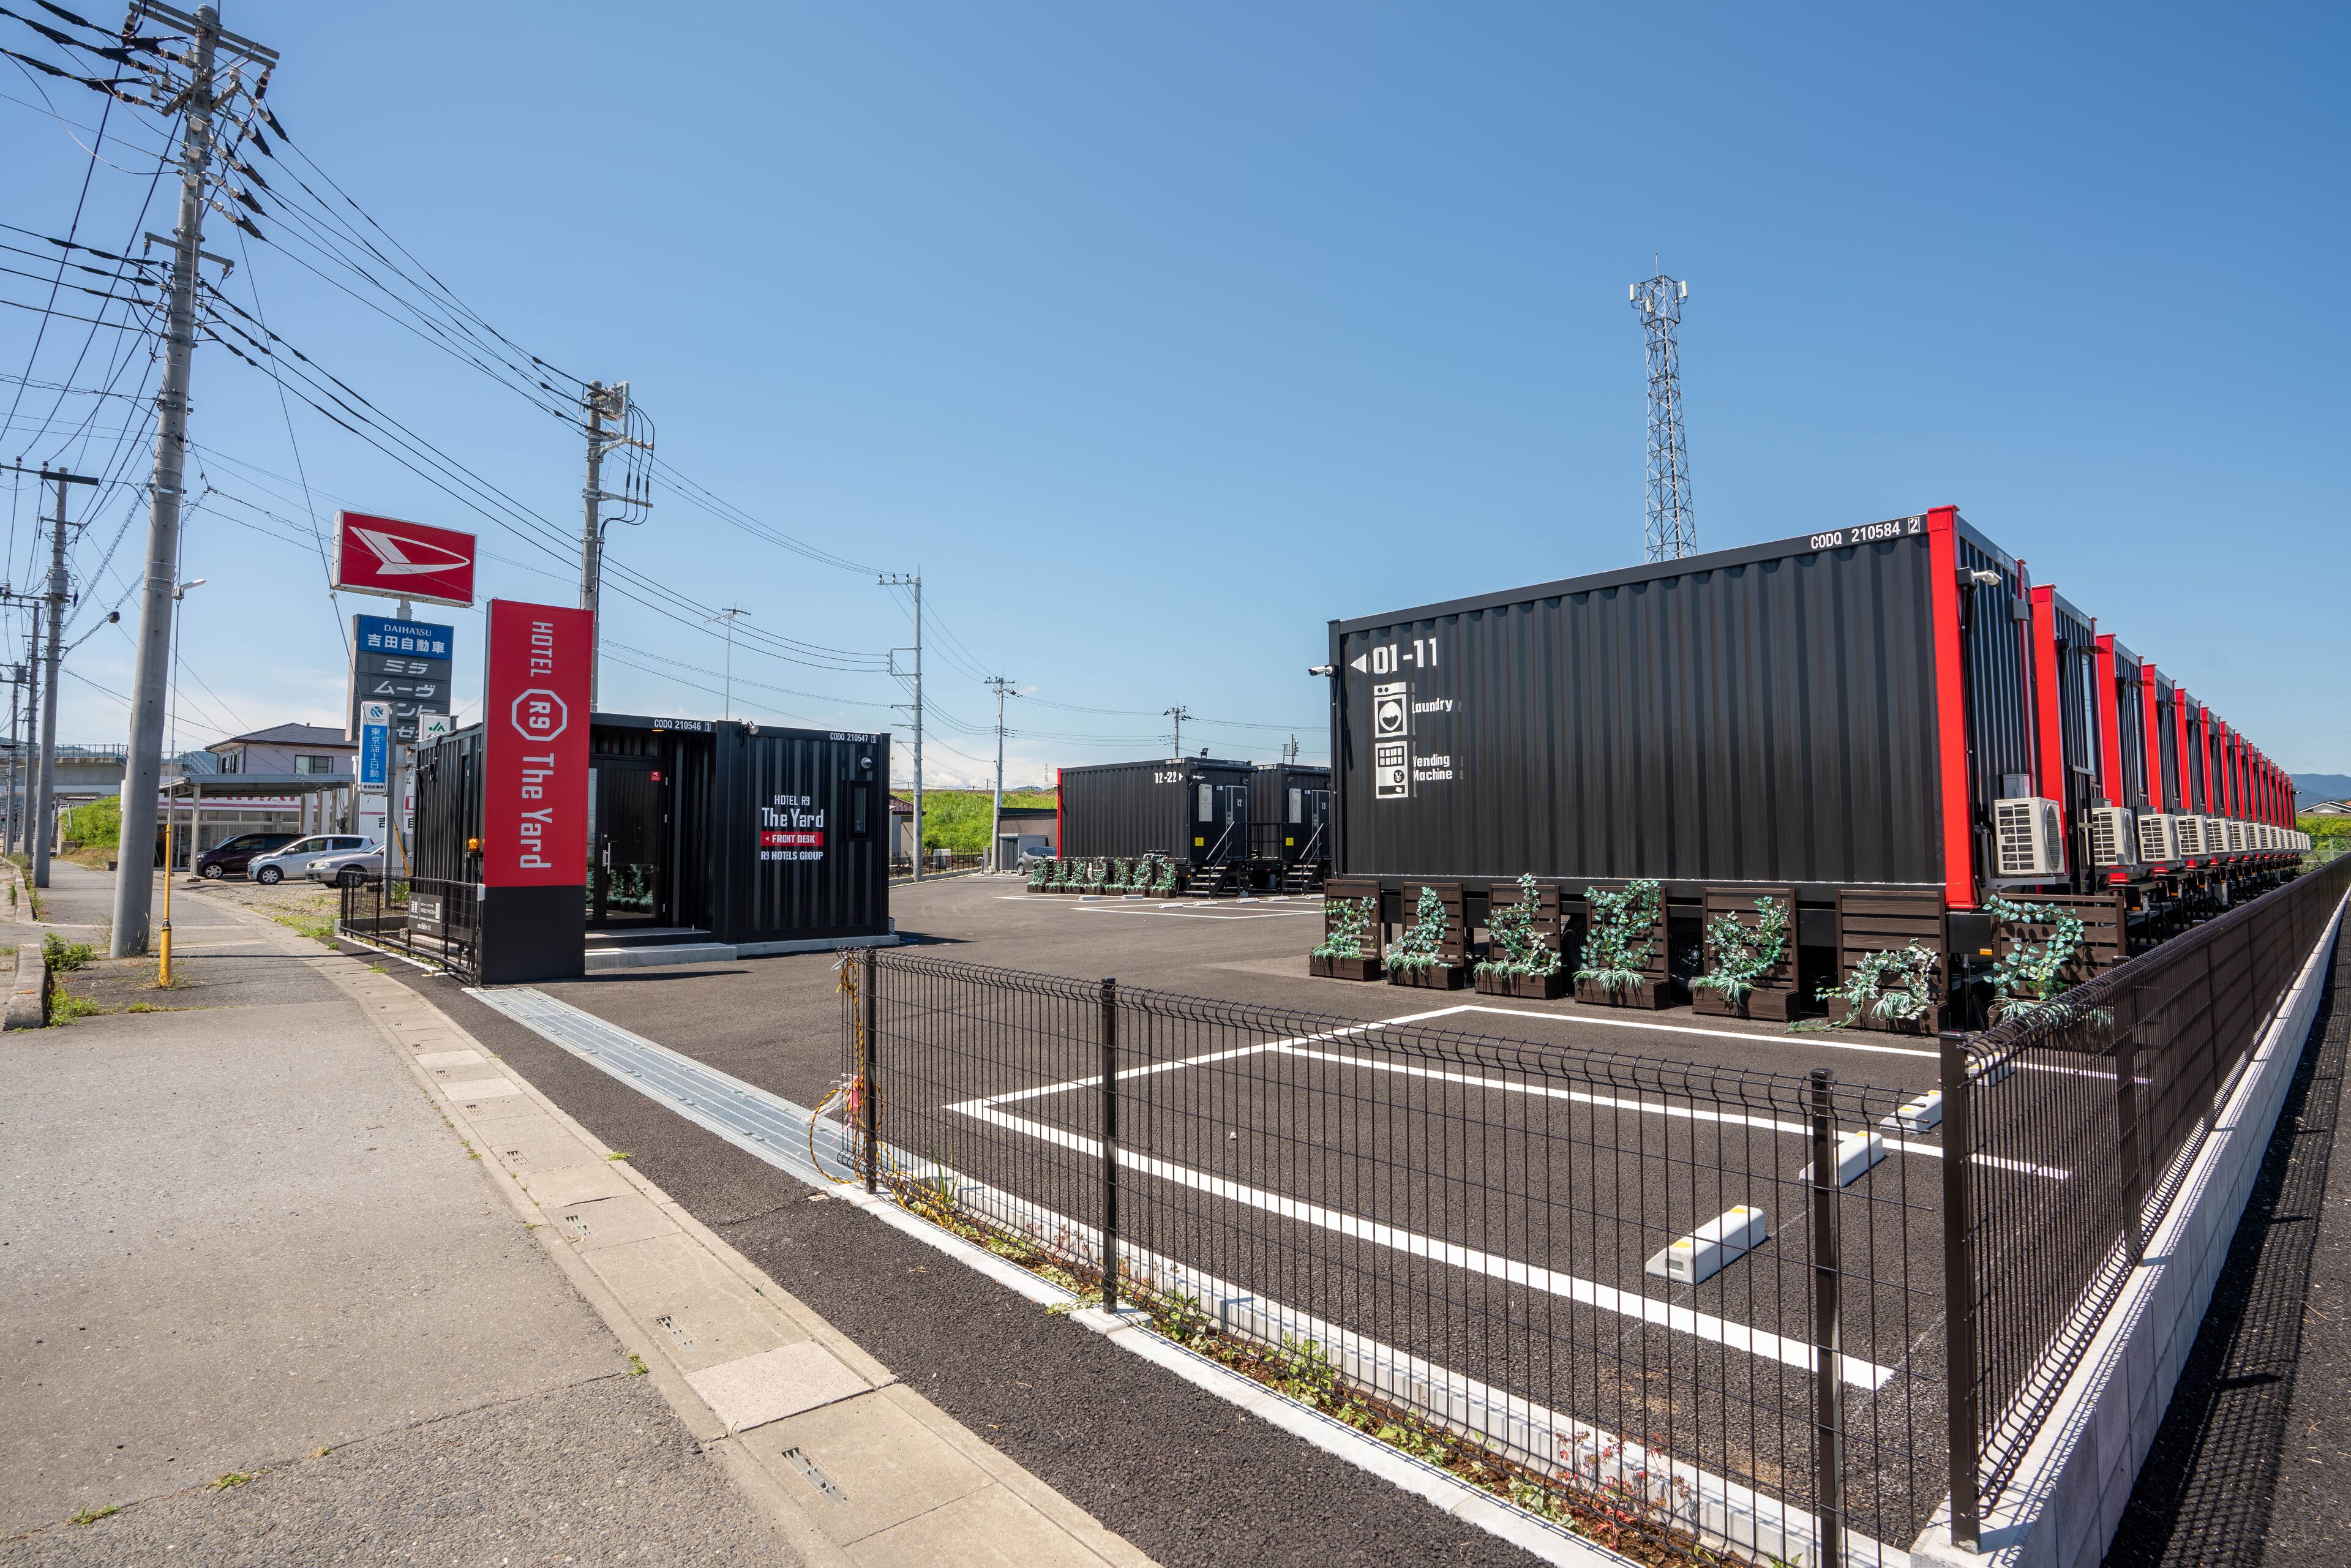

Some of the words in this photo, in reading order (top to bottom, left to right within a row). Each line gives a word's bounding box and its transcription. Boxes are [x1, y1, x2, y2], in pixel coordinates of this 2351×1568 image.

[1810, 531, 1842, 549] CODQ
[1851, 521, 1900, 542] 210584
[1909, 518, 1919, 533] 2
[384, 624, 432, 637] DAIHATSU
[368, 634, 444, 654] 吉田自動車
[530, 621, 553, 677] HOTEL
[1373, 637, 1437, 674] 01-11
[383, 659, 429, 674] ミラ
[373, 680, 436, 697] ムーヴ
[1412, 698, 1453, 714] Laundry
[530, 701, 550, 729] R9
[654, 719, 672, 729] CODQ
[675, 721, 701, 730] 210546
[705, 722, 710, 732] 1
[830, 732, 845, 741] CODQ
[847, 733, 868, 742] 210547
[872, 735, 876, 743] 1
[369, 727, 380, 778] 東京海上日動
[1412, 754, 1450, 768] Vending
[522, 752, 554, 800] The
[1154, 771, 1177, 784] 12-22
[1413, 768, 1453, 782] Machine
[774, 795, 798, 805] HOTEL
[801, 796, 810, 806] R9
[1237, 798, 1242, 807] 12
[762, 807, 788, 827] The
[790, 808, 824, 828] Yard
[520, 808, 553, 868] Yard
[772, 835, 795, 843] FRONT
[797, 835, 816, 843] DESK
[761, 851, 770, 860] R9
[771, 851, 797, 860] HOTELS
[800, 851, 823, 860] GROUP
